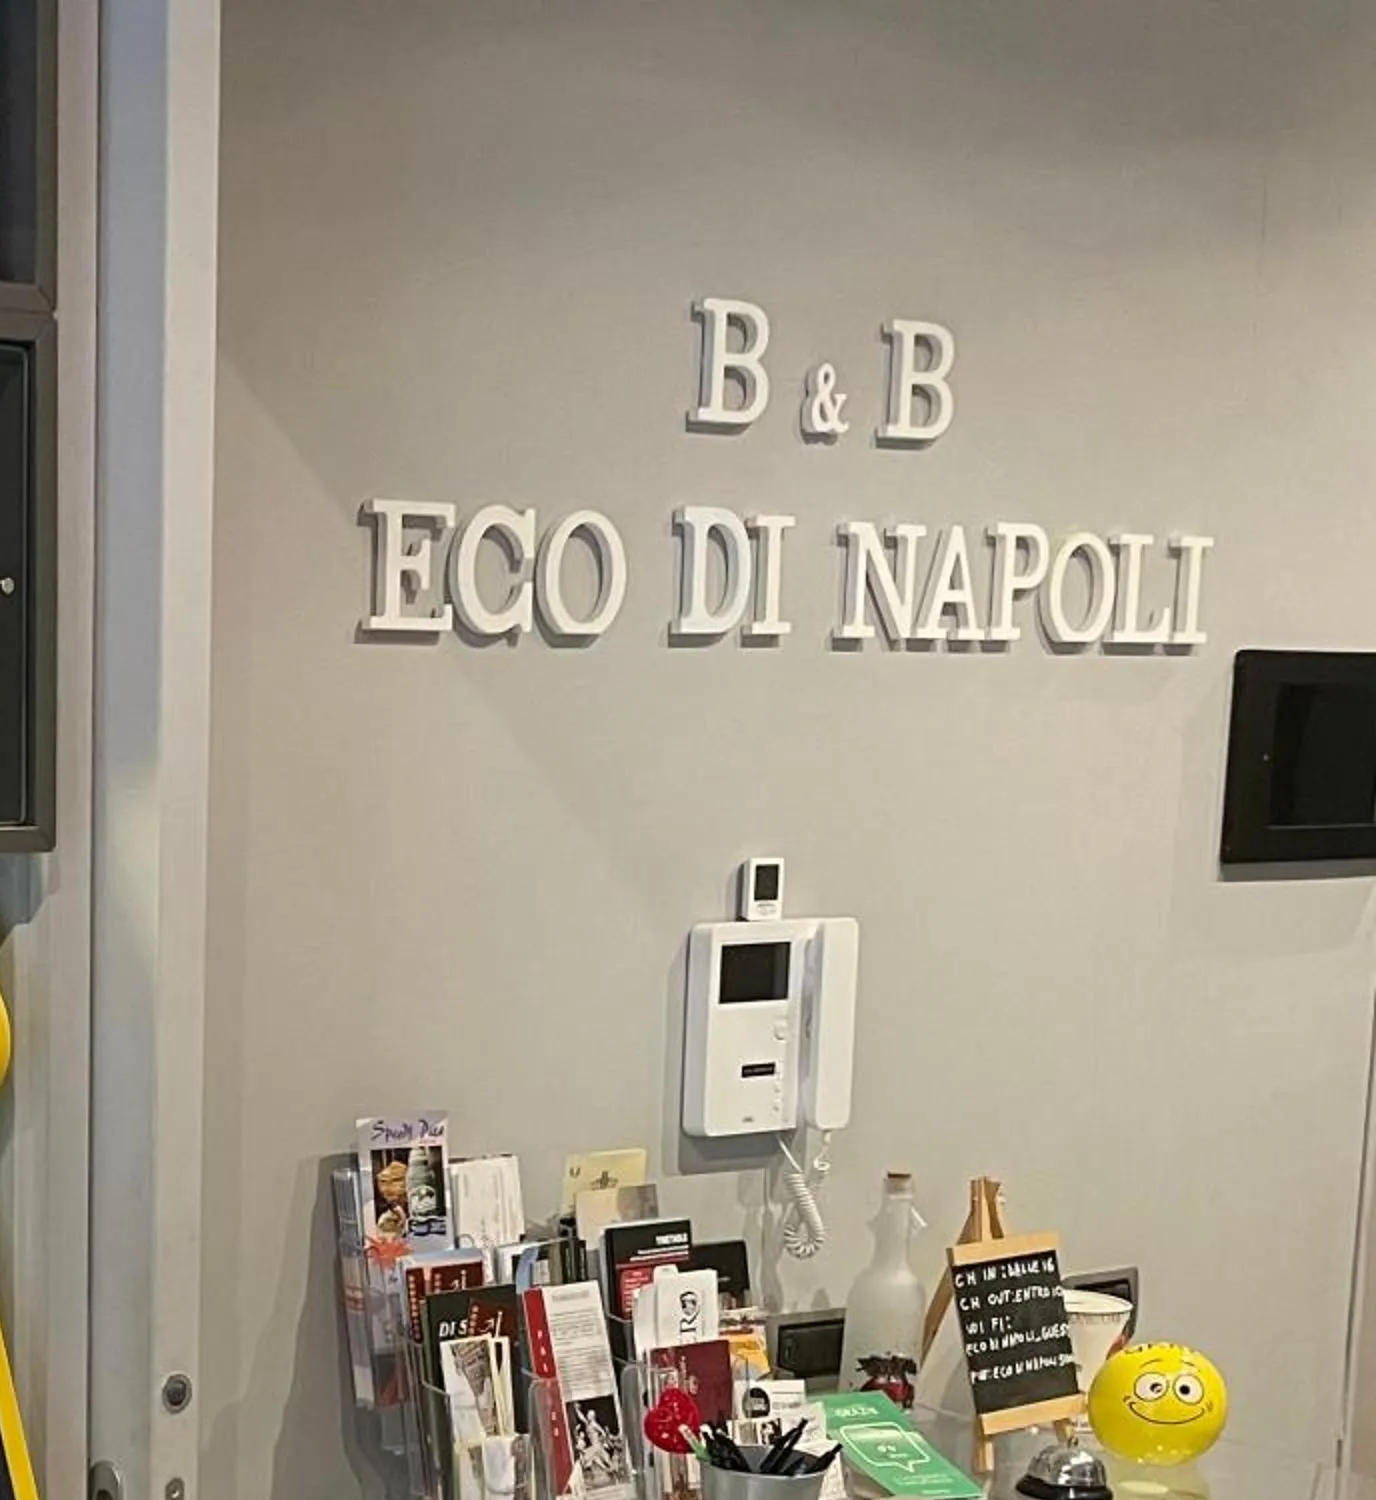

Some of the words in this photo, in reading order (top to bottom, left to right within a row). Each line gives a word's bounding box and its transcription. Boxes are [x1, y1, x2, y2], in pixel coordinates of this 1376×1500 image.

[691, 297, 772, 427] B
[804, 361, 850, 440] &
[881, 318, 957, 444] B
[359, 497, 629, 640] ECO
[672, 504, 797, 640] DI
[836, 519, 1215, 648] NAPOLI
